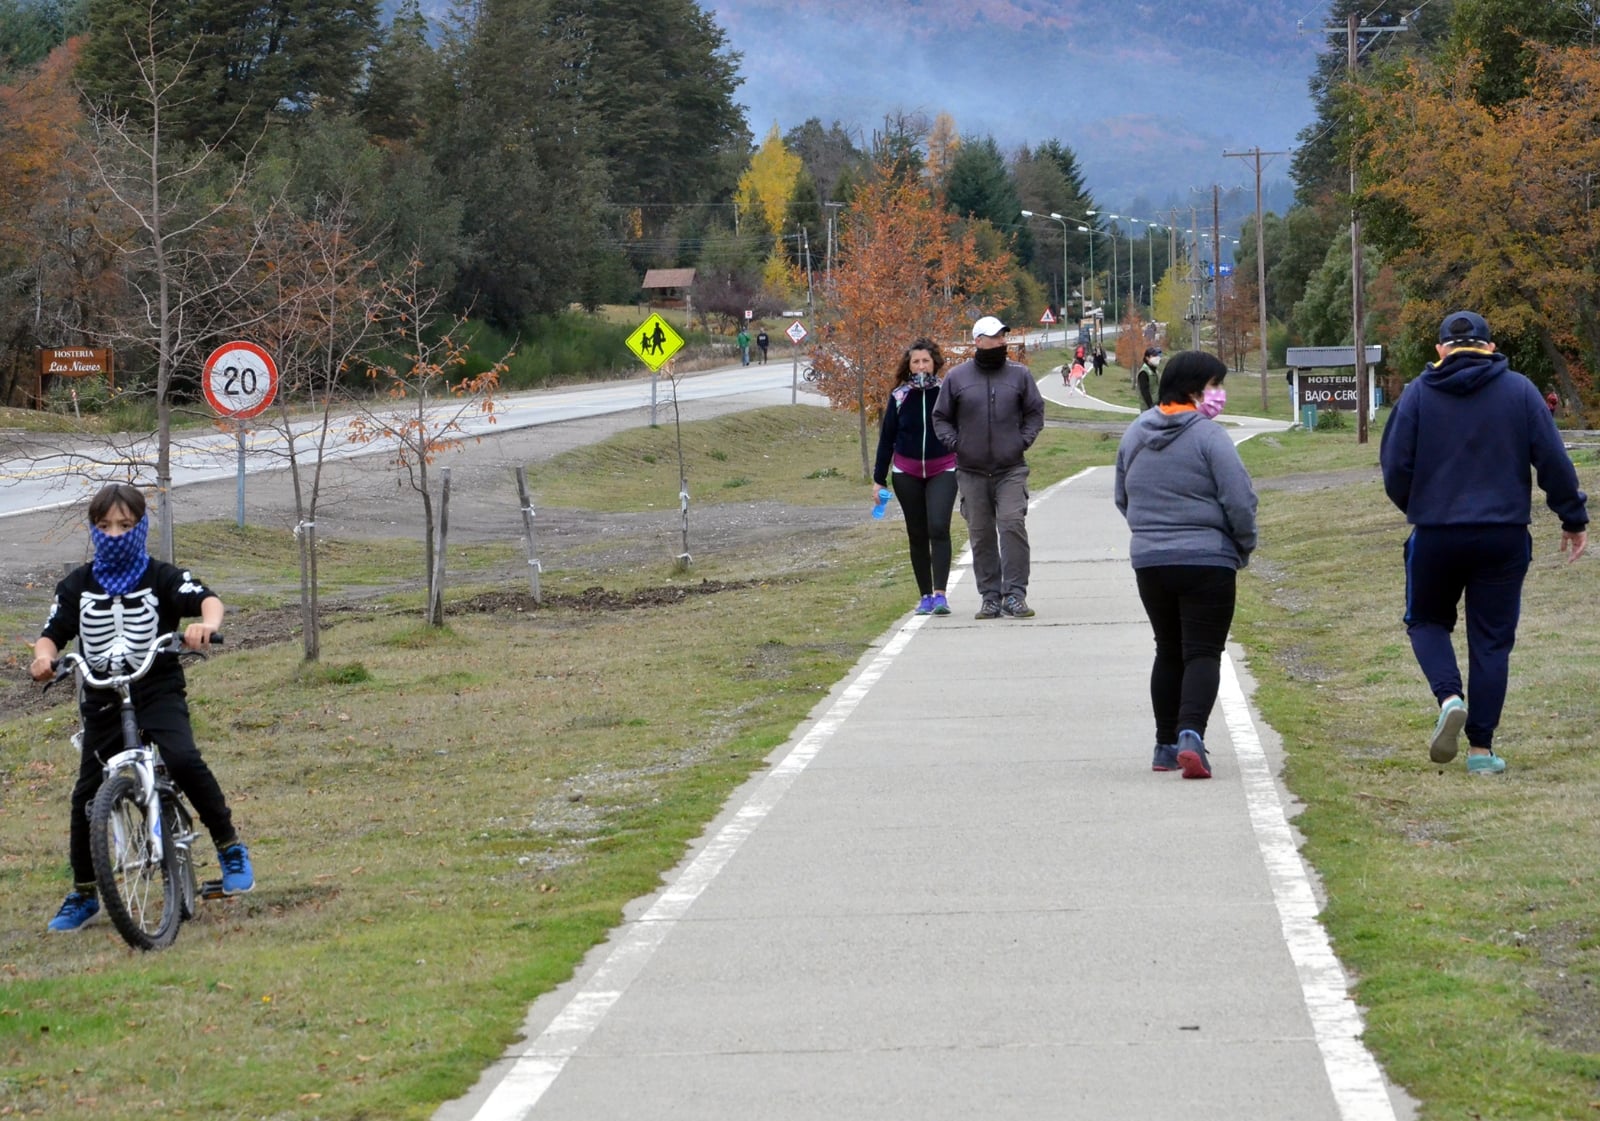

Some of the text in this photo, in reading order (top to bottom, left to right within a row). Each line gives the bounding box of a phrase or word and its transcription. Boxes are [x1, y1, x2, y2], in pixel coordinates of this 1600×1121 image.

[54, 350, 94, 358] HOSTERIA
[49, 361, 101, 372] Las Nieves
[224, 366, 257, 396] 20
[1308, 375, 1358, 384] HOSTERIA
[1305, 390, 1331, 402] BAJO
